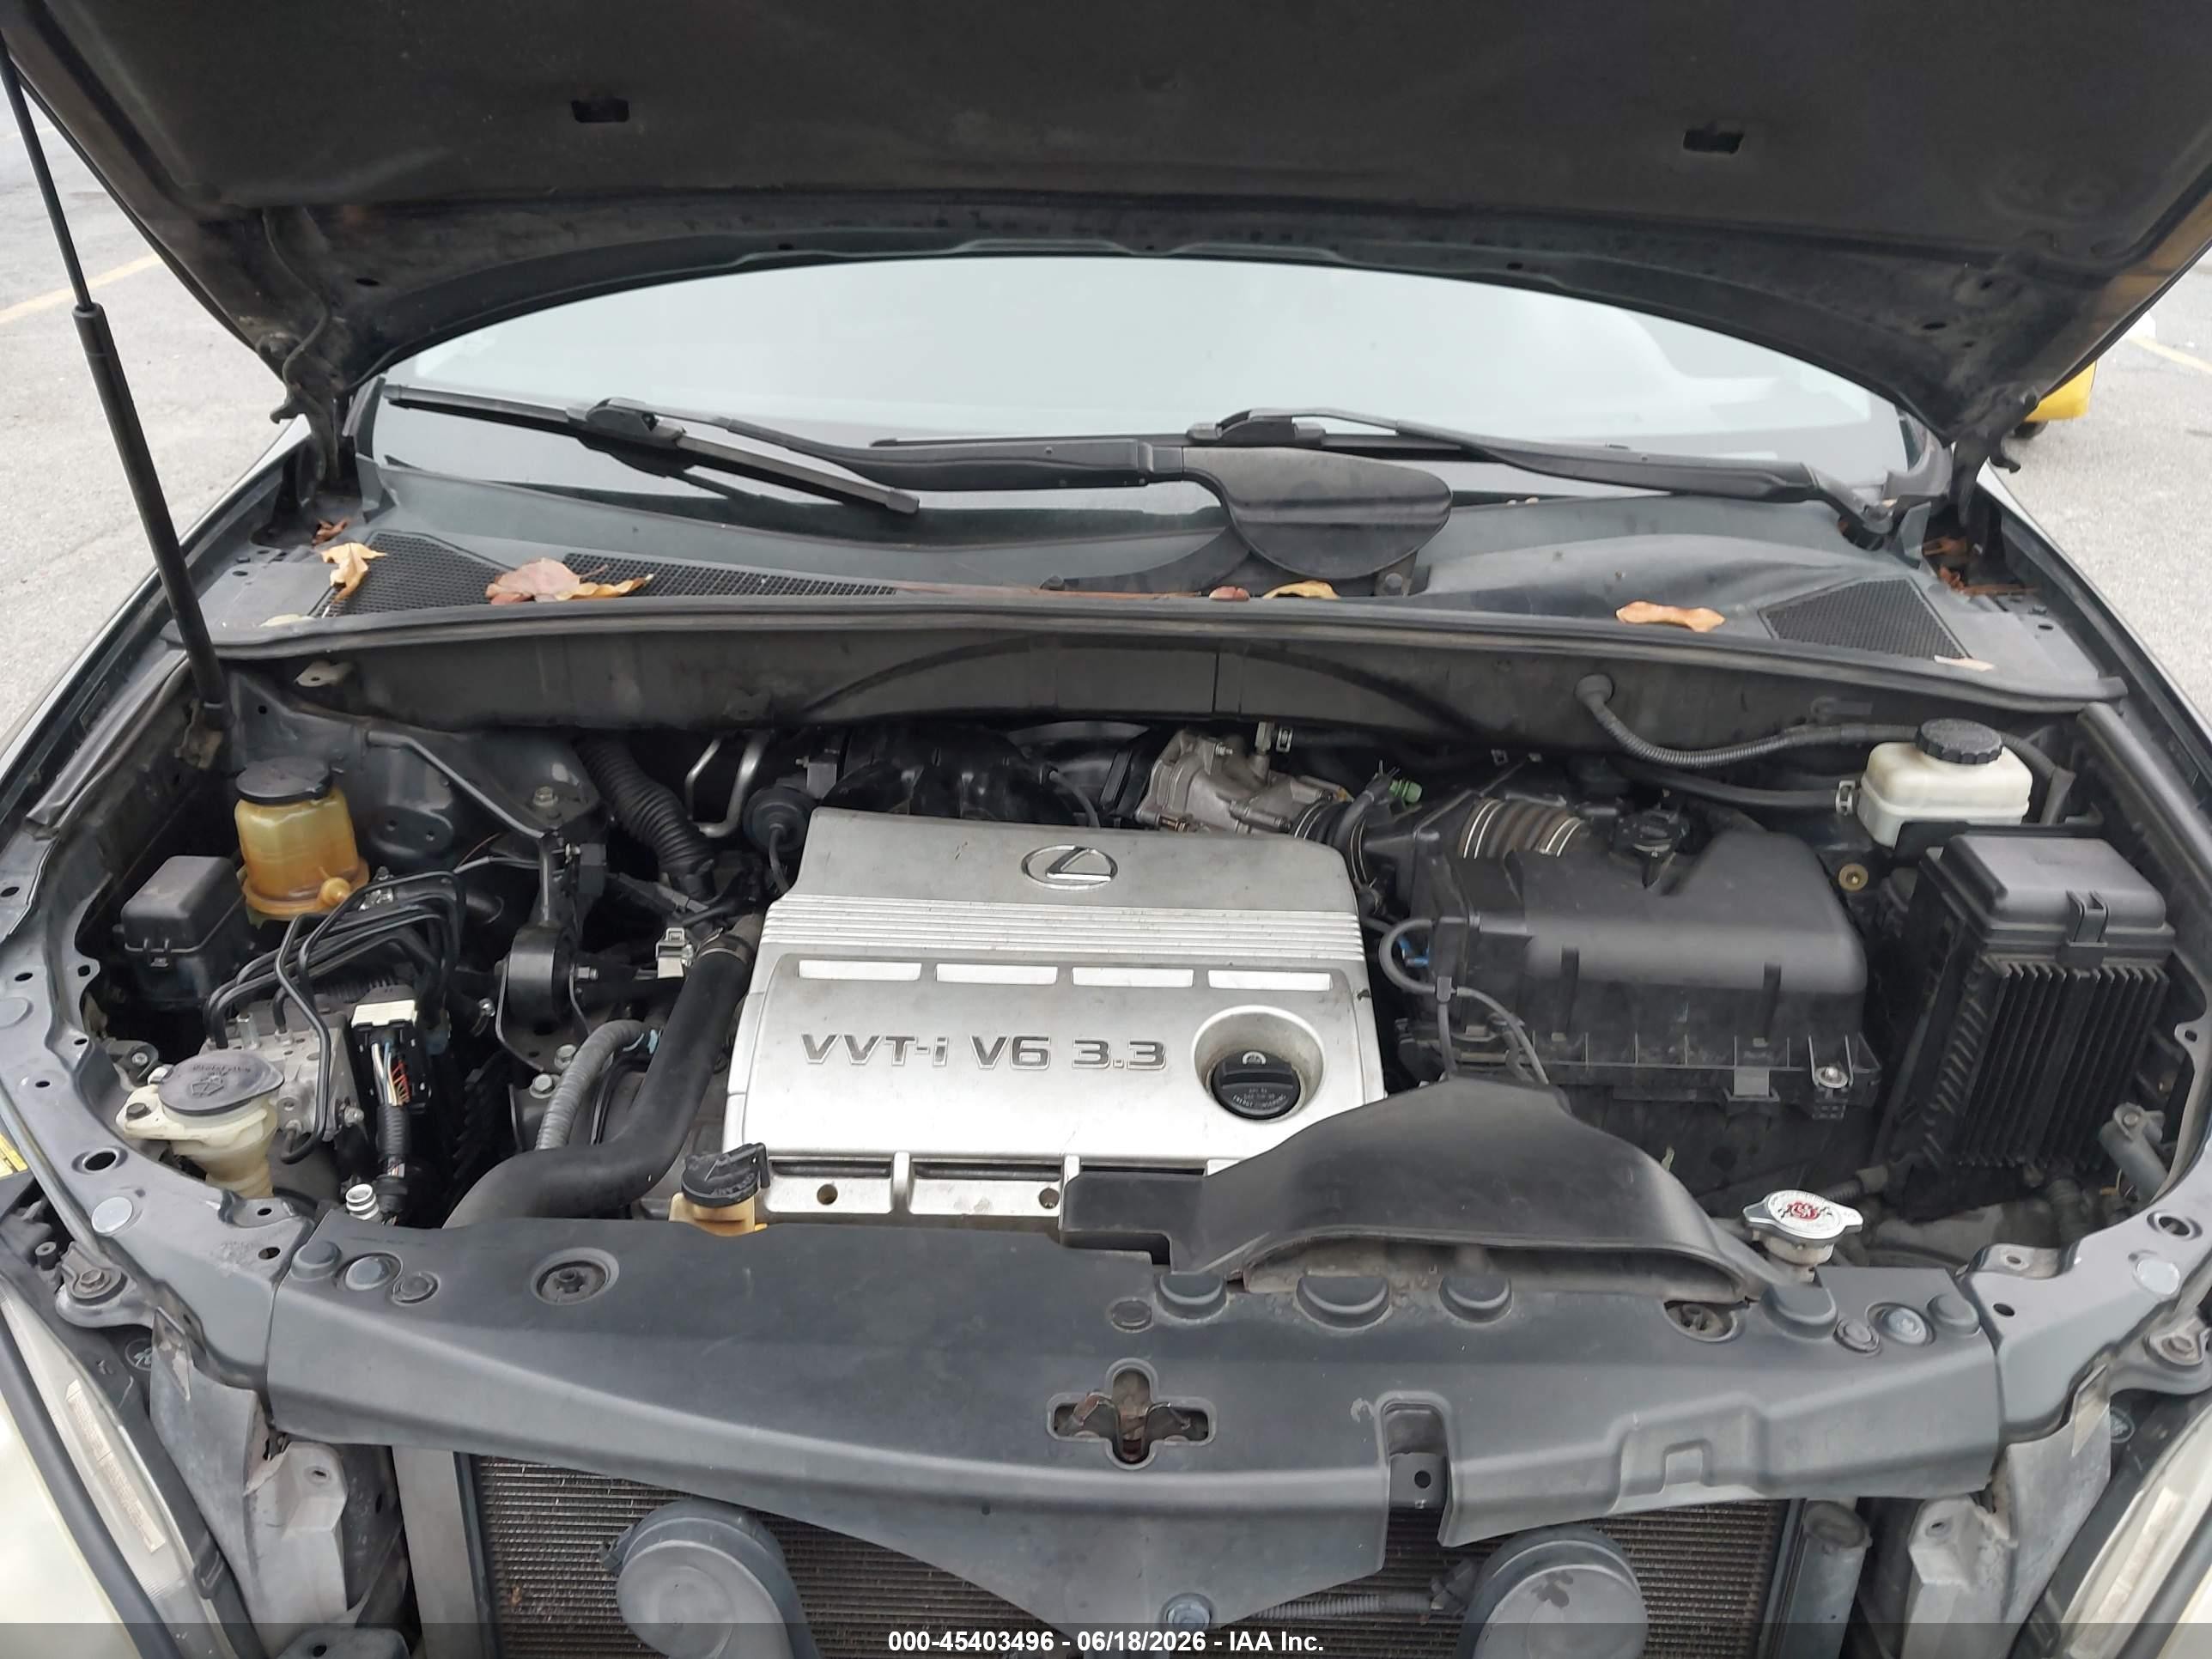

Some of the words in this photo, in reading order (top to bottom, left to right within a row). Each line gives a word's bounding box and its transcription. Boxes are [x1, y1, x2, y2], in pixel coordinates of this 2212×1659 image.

[801, 1033, 950, 1066] VVT-i
[970, 1034, 1051, 1071] V6
[1071, 1038, 1167, 1071] 3.3
